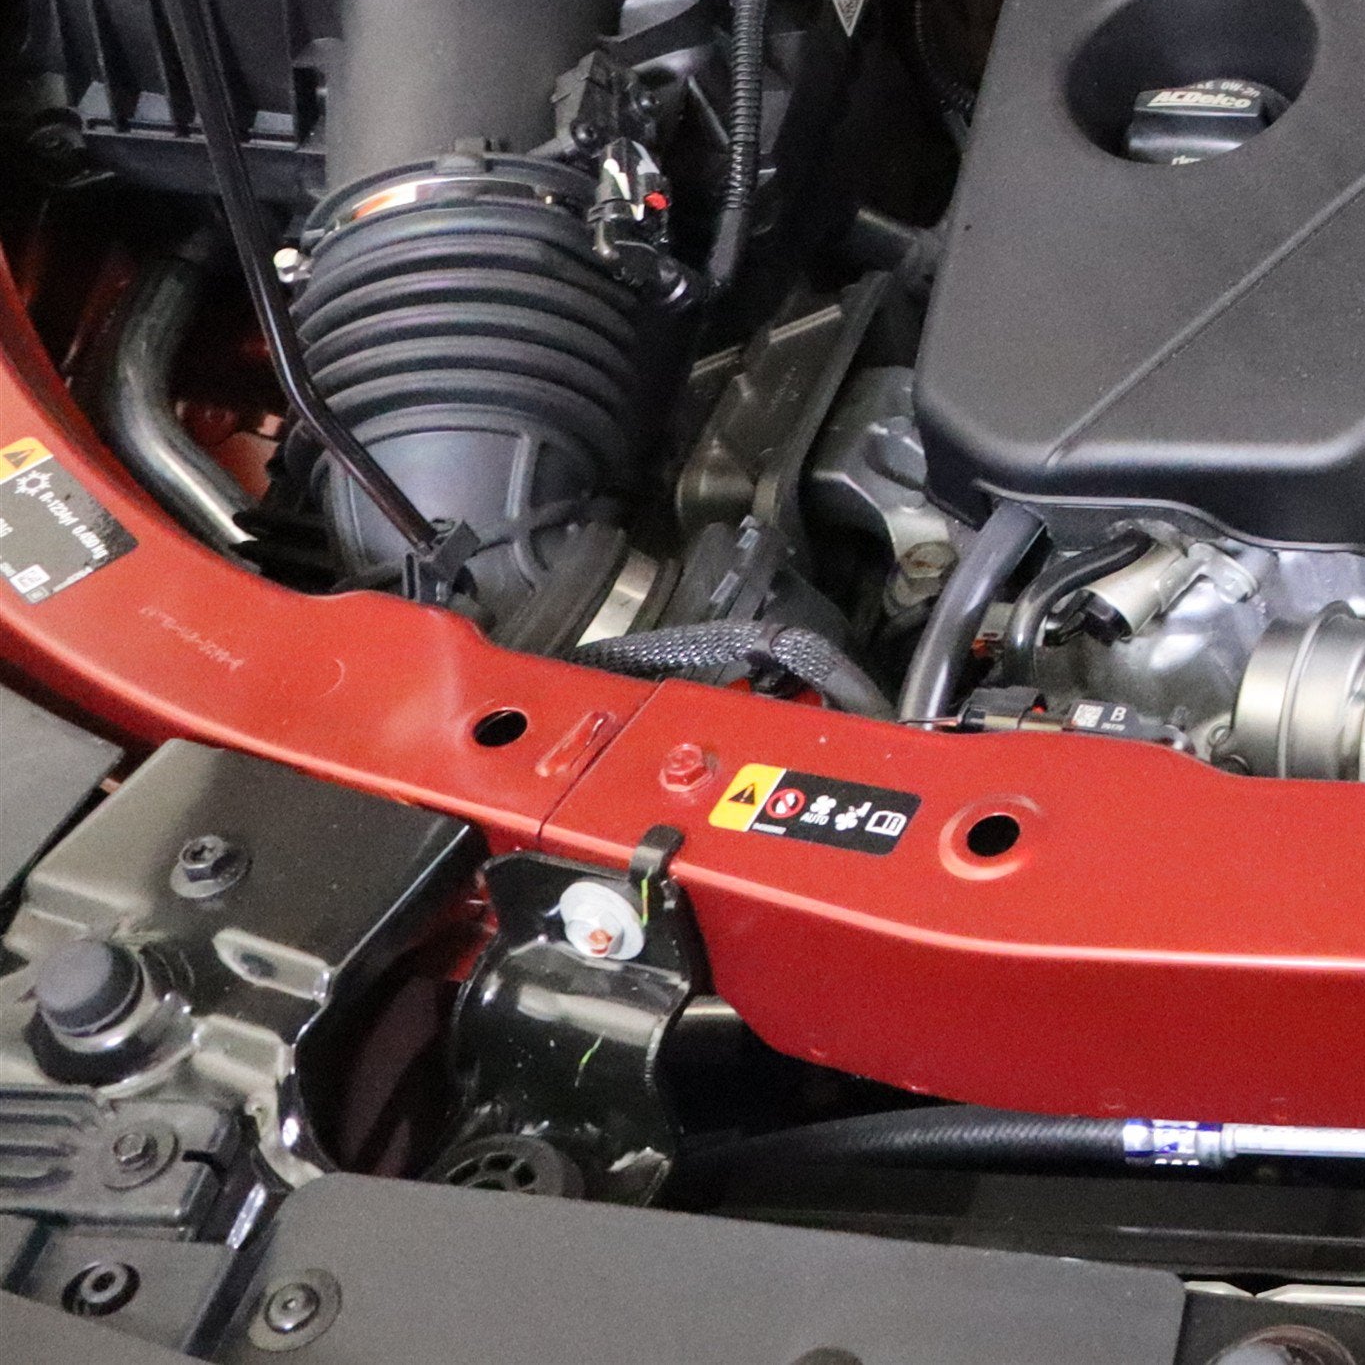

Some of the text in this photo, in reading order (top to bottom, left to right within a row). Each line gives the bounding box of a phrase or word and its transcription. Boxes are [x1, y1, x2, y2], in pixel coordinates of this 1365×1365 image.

[1149, 91, 1252, 108] ACDelco
[1110, 706, 1127, 722] B
[800, 812, 829, 825] AUTO
